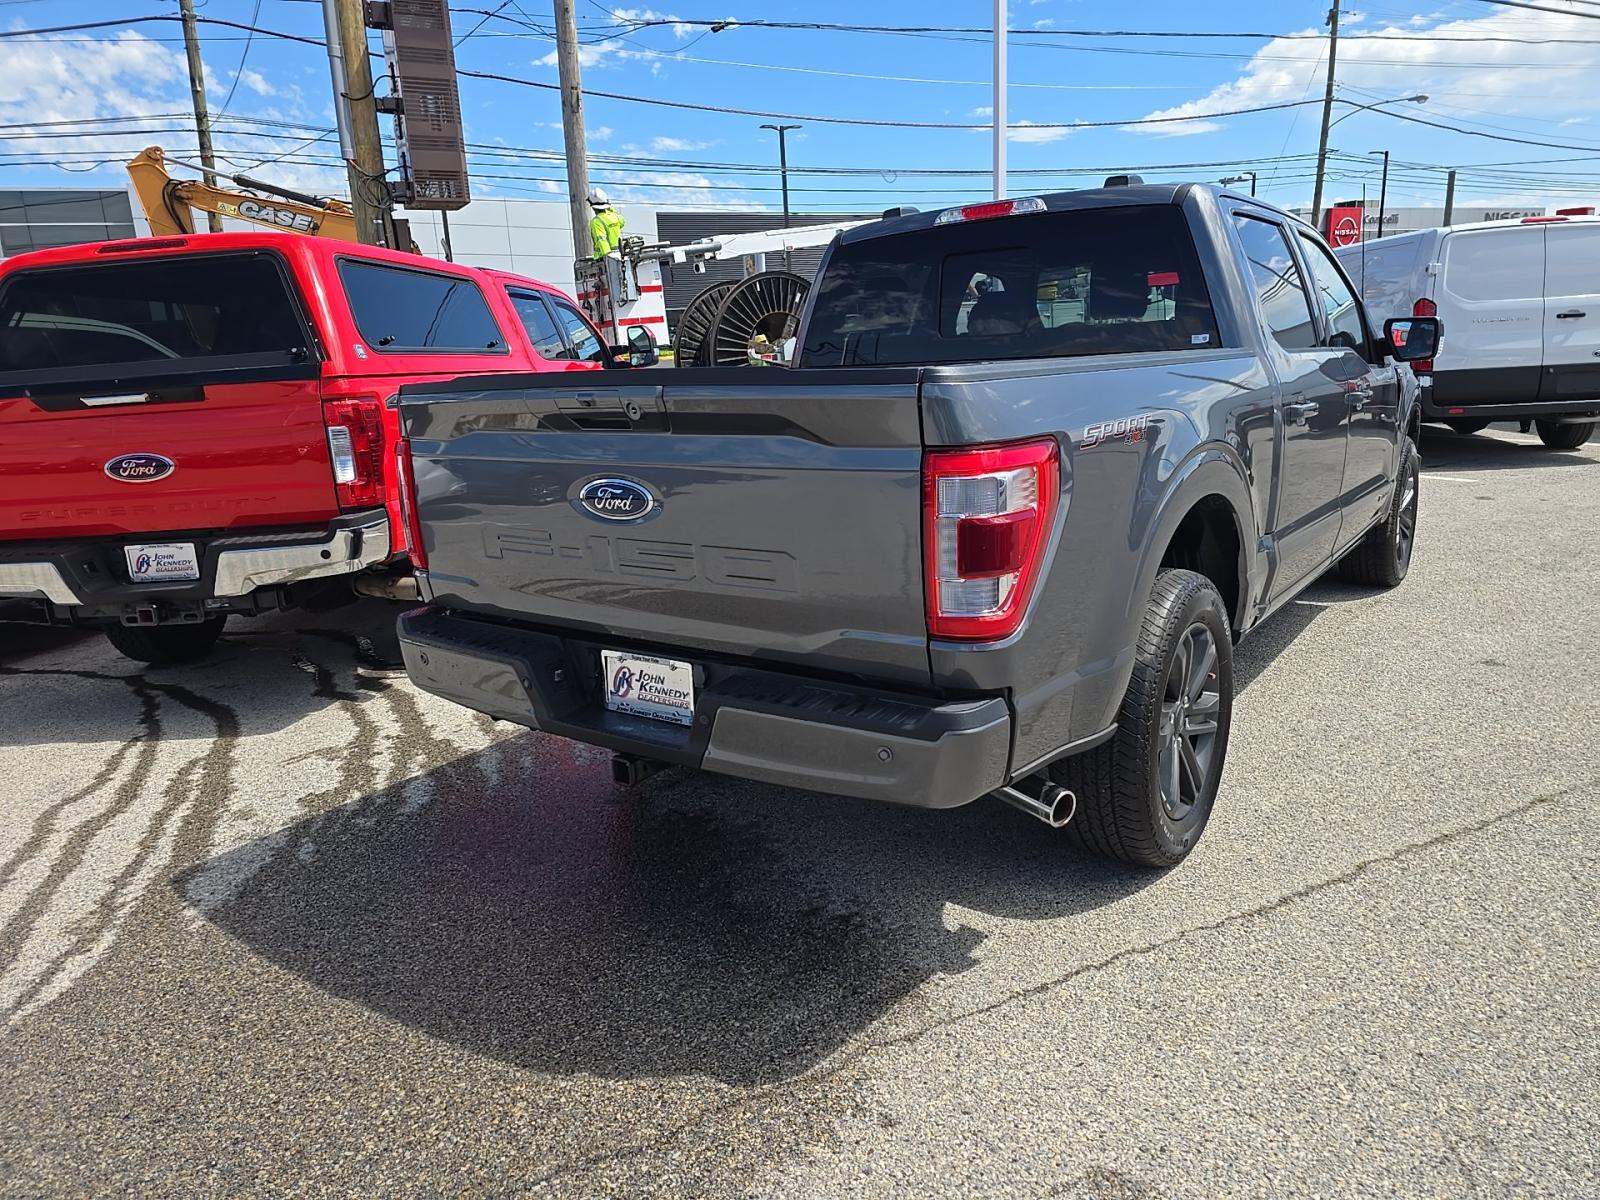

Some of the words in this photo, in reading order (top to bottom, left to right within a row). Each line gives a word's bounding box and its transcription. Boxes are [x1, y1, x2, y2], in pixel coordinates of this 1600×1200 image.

[238, 200, 312, 232] CASE
[1334, 228, 1359, 236] NISSAN
[1080, 412, 1152, 450] SPORT
[120, 459, 157, 477] Ford
[594, 486, 634, 511] Ford
[20, 504, 157, 521] SUPER
[168, 496, 277, 512] DUTY
[152, 553, 175, 562] JOHN
[156, 559, 193, 567] KENNEDY
[482, 523, 797, 592] F-150
[635, 669, 666, 686] JOHN
[639, 680, 690, 700] KENNEDY
[637, 693, 690, 710] DEALERSHIPS
